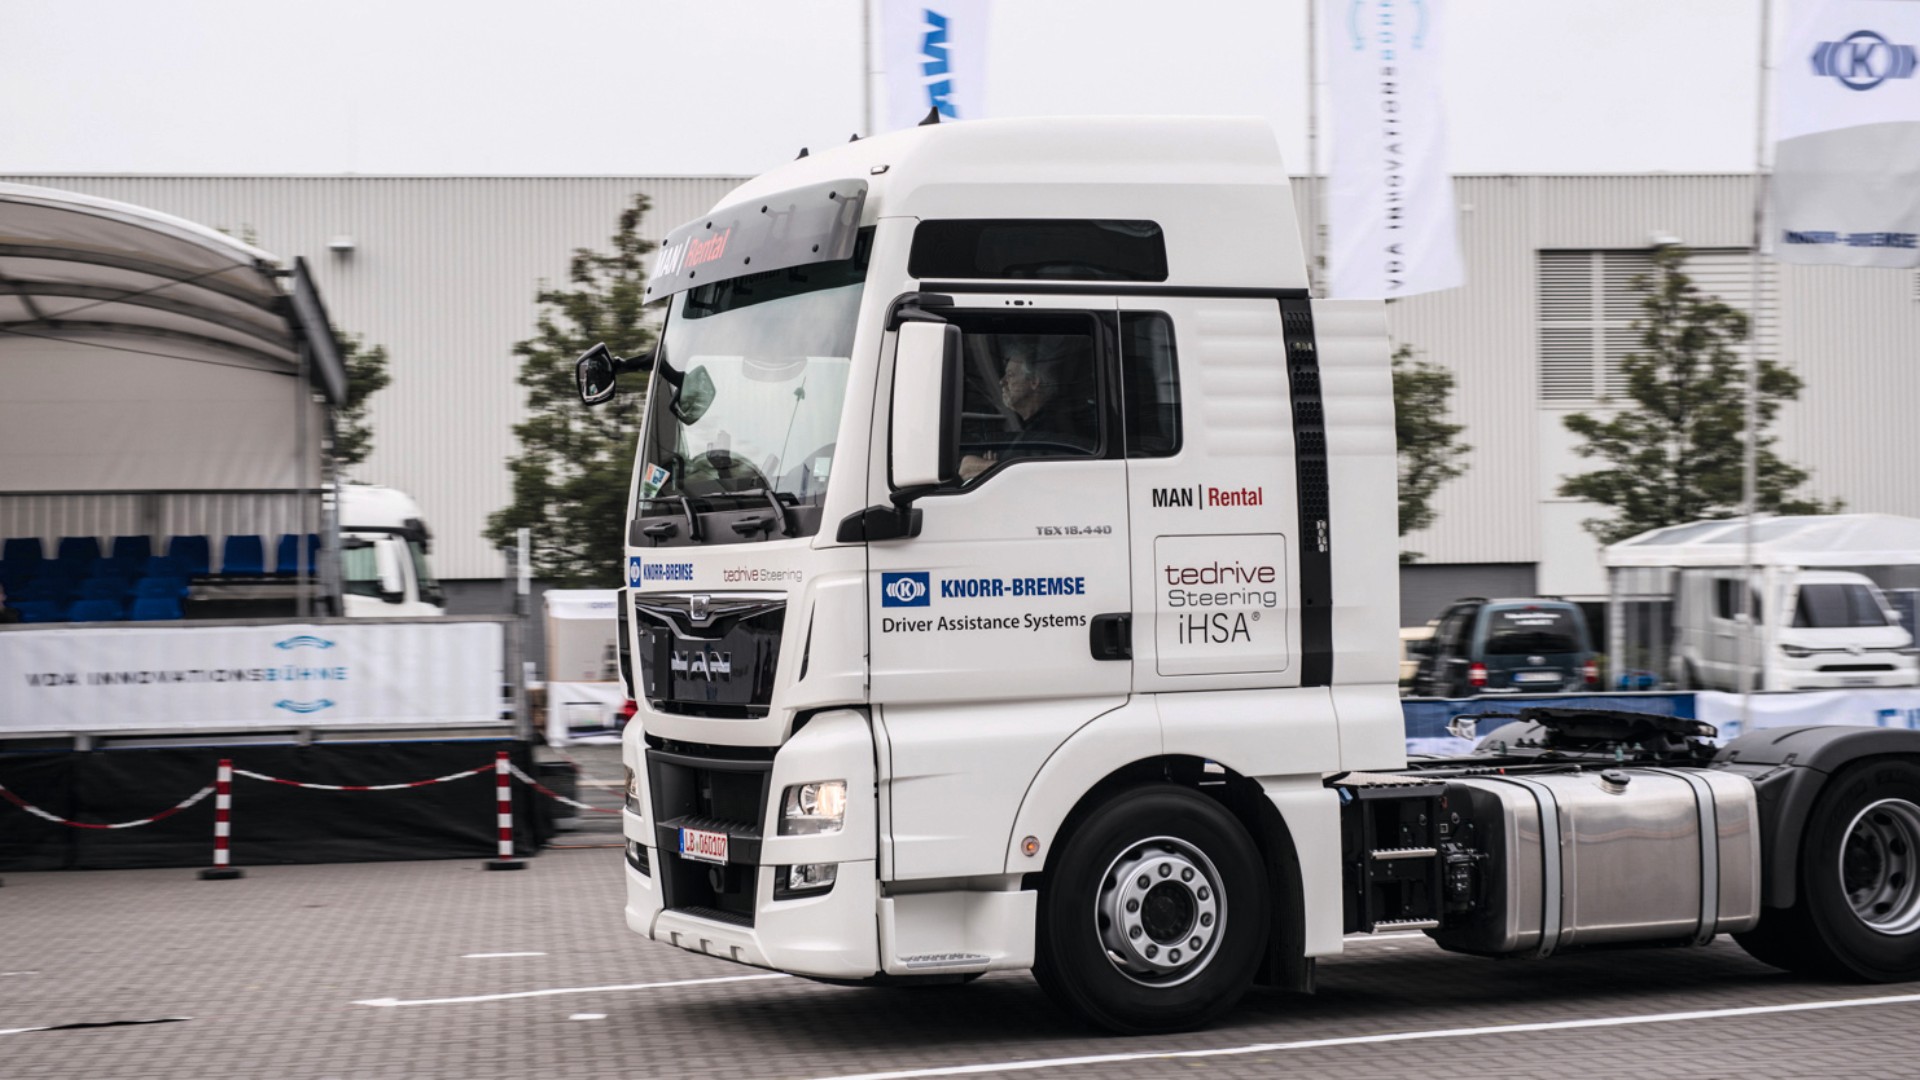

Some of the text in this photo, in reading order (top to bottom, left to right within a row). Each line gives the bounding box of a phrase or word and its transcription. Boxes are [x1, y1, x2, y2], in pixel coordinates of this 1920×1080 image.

[684, 226, 731, 269] Rental
[1152, 486, 1263, 508] MAN Rental
[643, 563, 693, 581] KNORR-BREMSE
[760, 567, 803, 583] Steering
[1165, 561, 1276, 585] tedrive
[941, 577, 1085, 598] KNORR-BREMSE
[1168, 588, 1277, 608] Steering
[882, 613, 1087, 633] Driver Assistance Systems
[671, 651, 732, 683] MAN
[685, 831, 695, 851] LB
